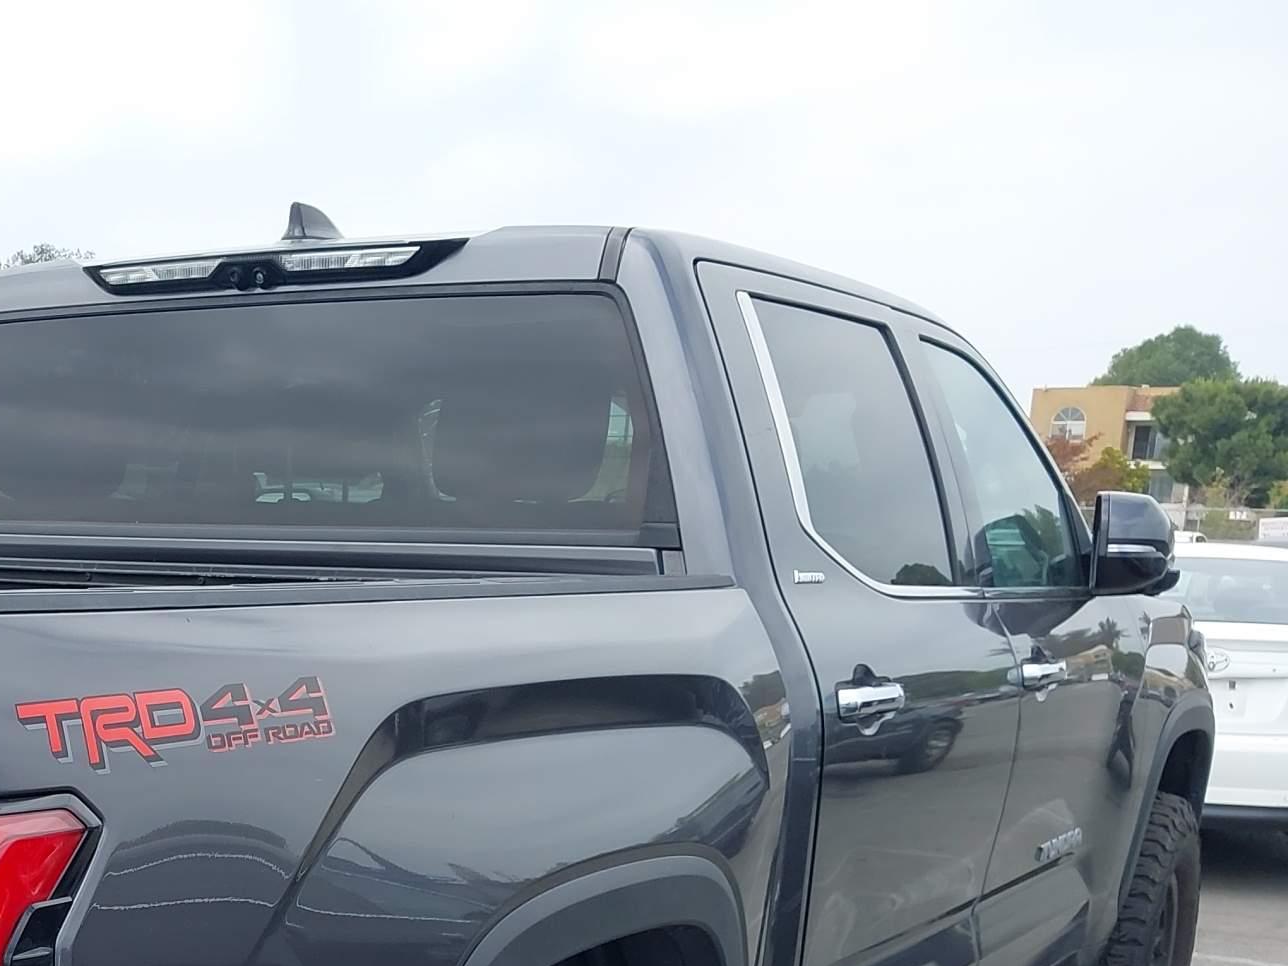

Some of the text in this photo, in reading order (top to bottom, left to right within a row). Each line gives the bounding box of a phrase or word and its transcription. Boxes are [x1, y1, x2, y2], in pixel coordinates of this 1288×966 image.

[15, 675, 334, 774] TRD 4x4
[207, 719, 337, 753] OFF ROAD
